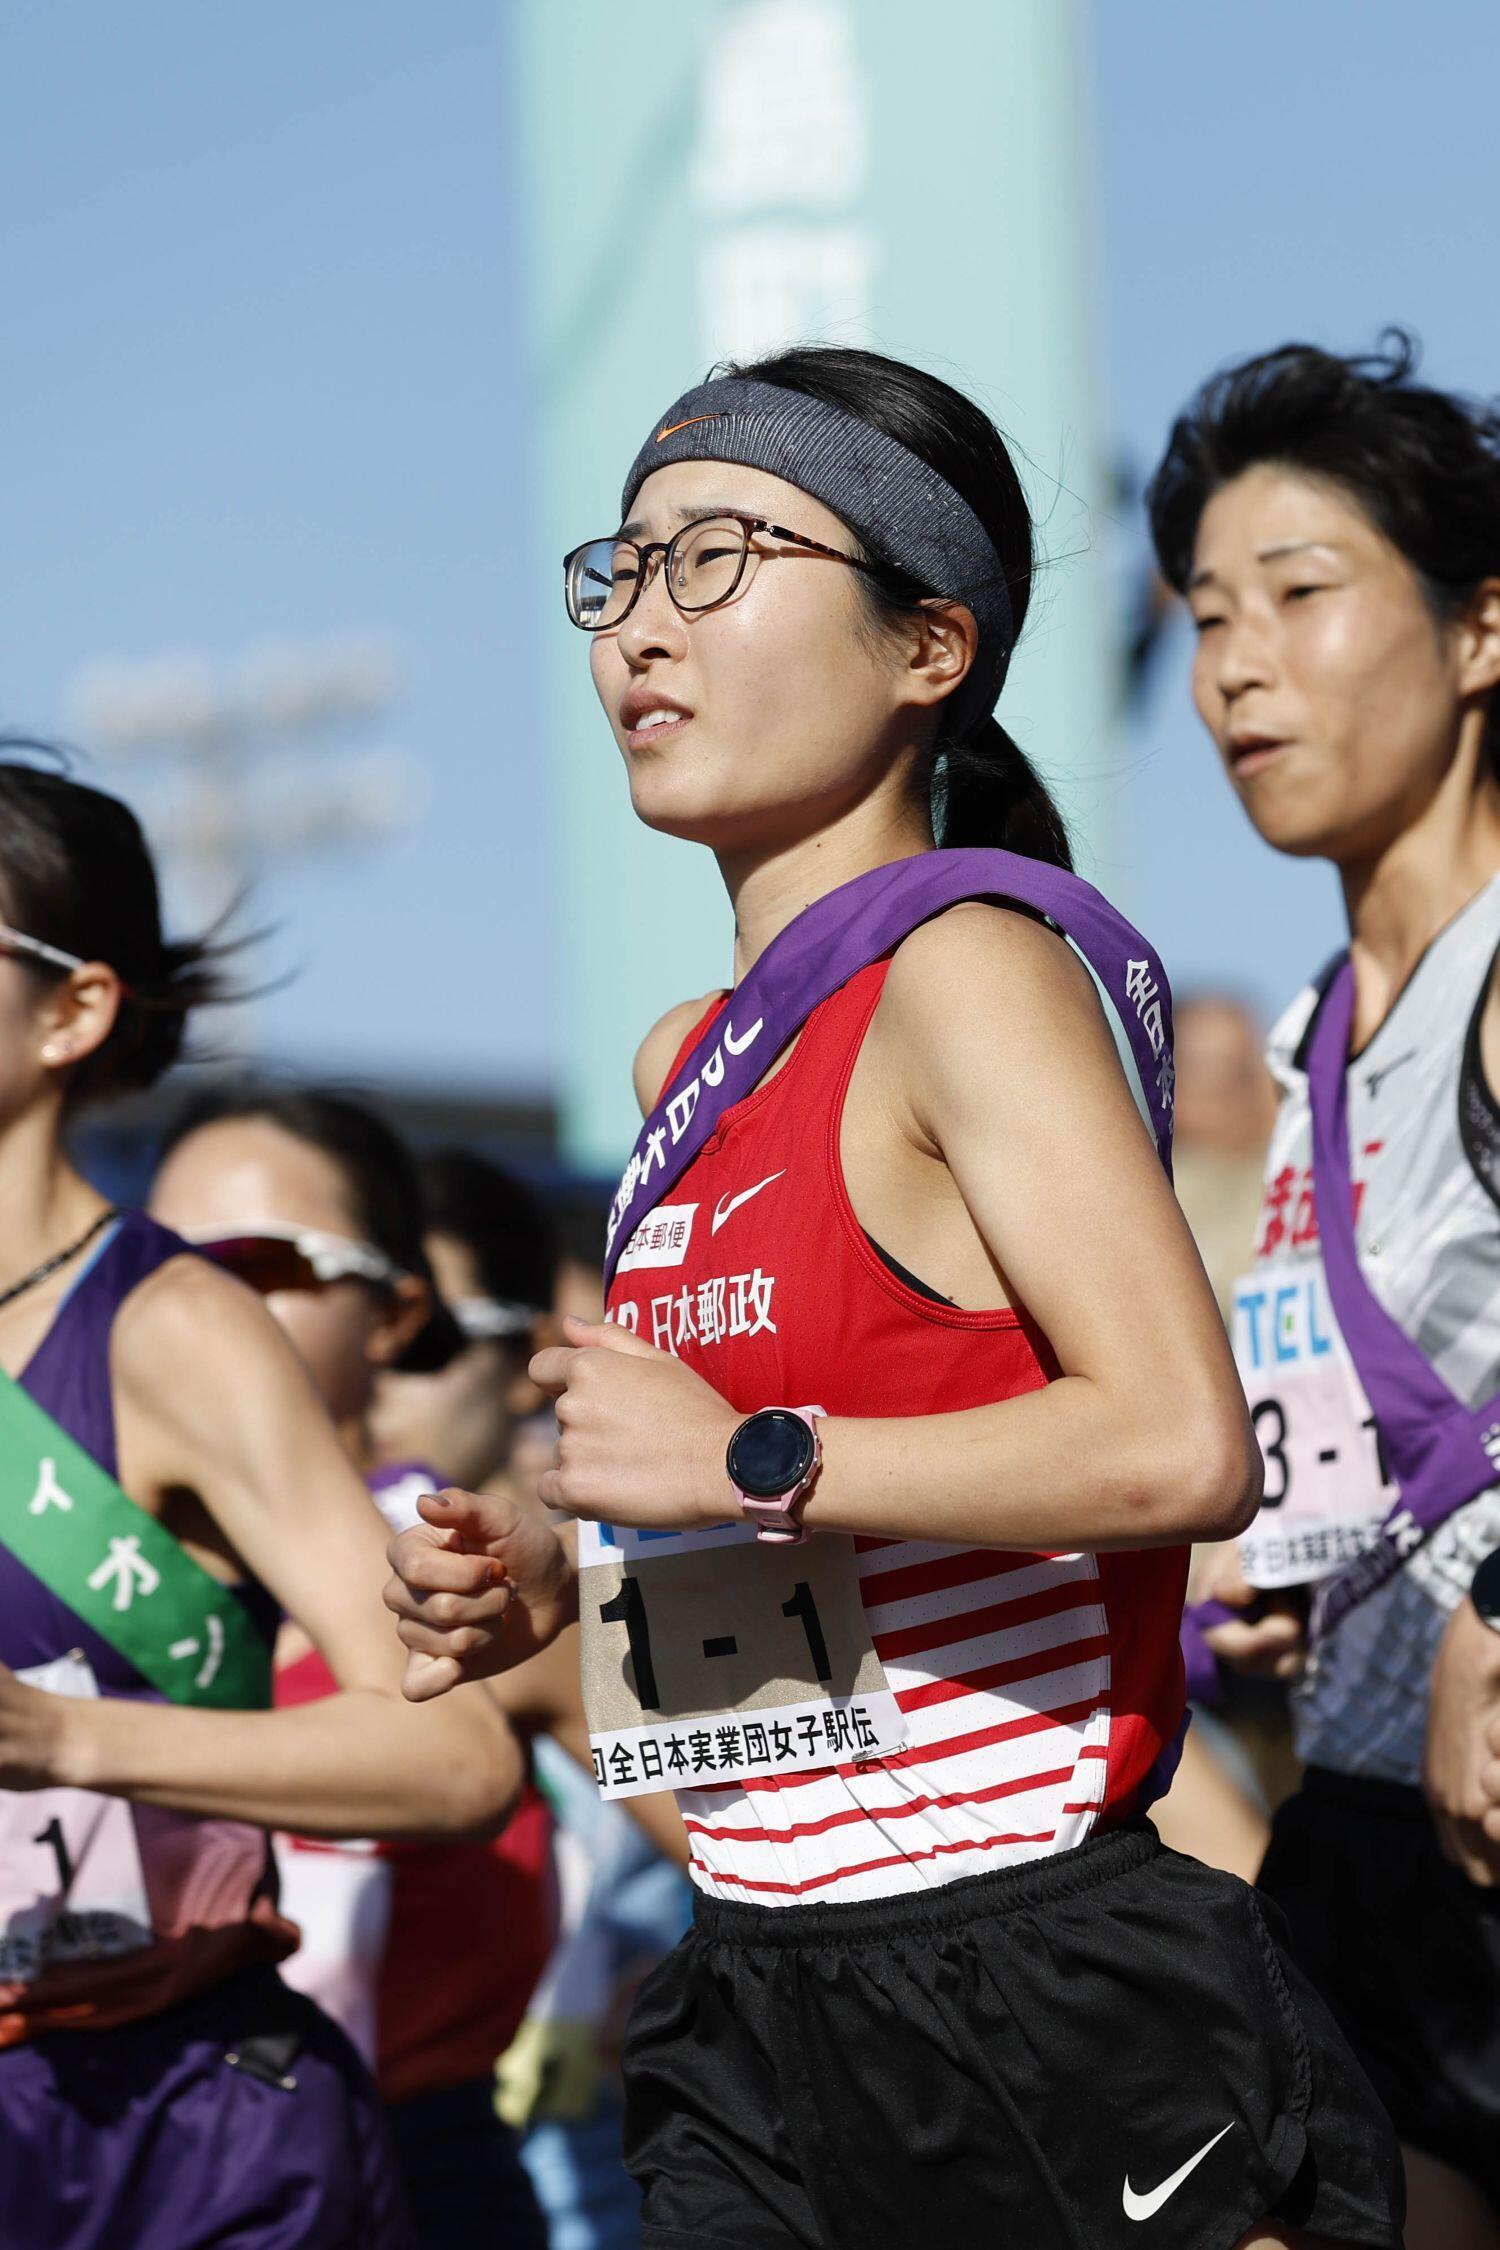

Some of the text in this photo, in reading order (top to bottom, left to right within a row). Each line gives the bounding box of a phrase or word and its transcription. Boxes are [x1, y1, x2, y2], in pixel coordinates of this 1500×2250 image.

[1125, 958, 1174, 1135] 全日本
[651, 1268, 777, 1358] 日本郵政
[1237, 1282, 1331, 1366] TEL
